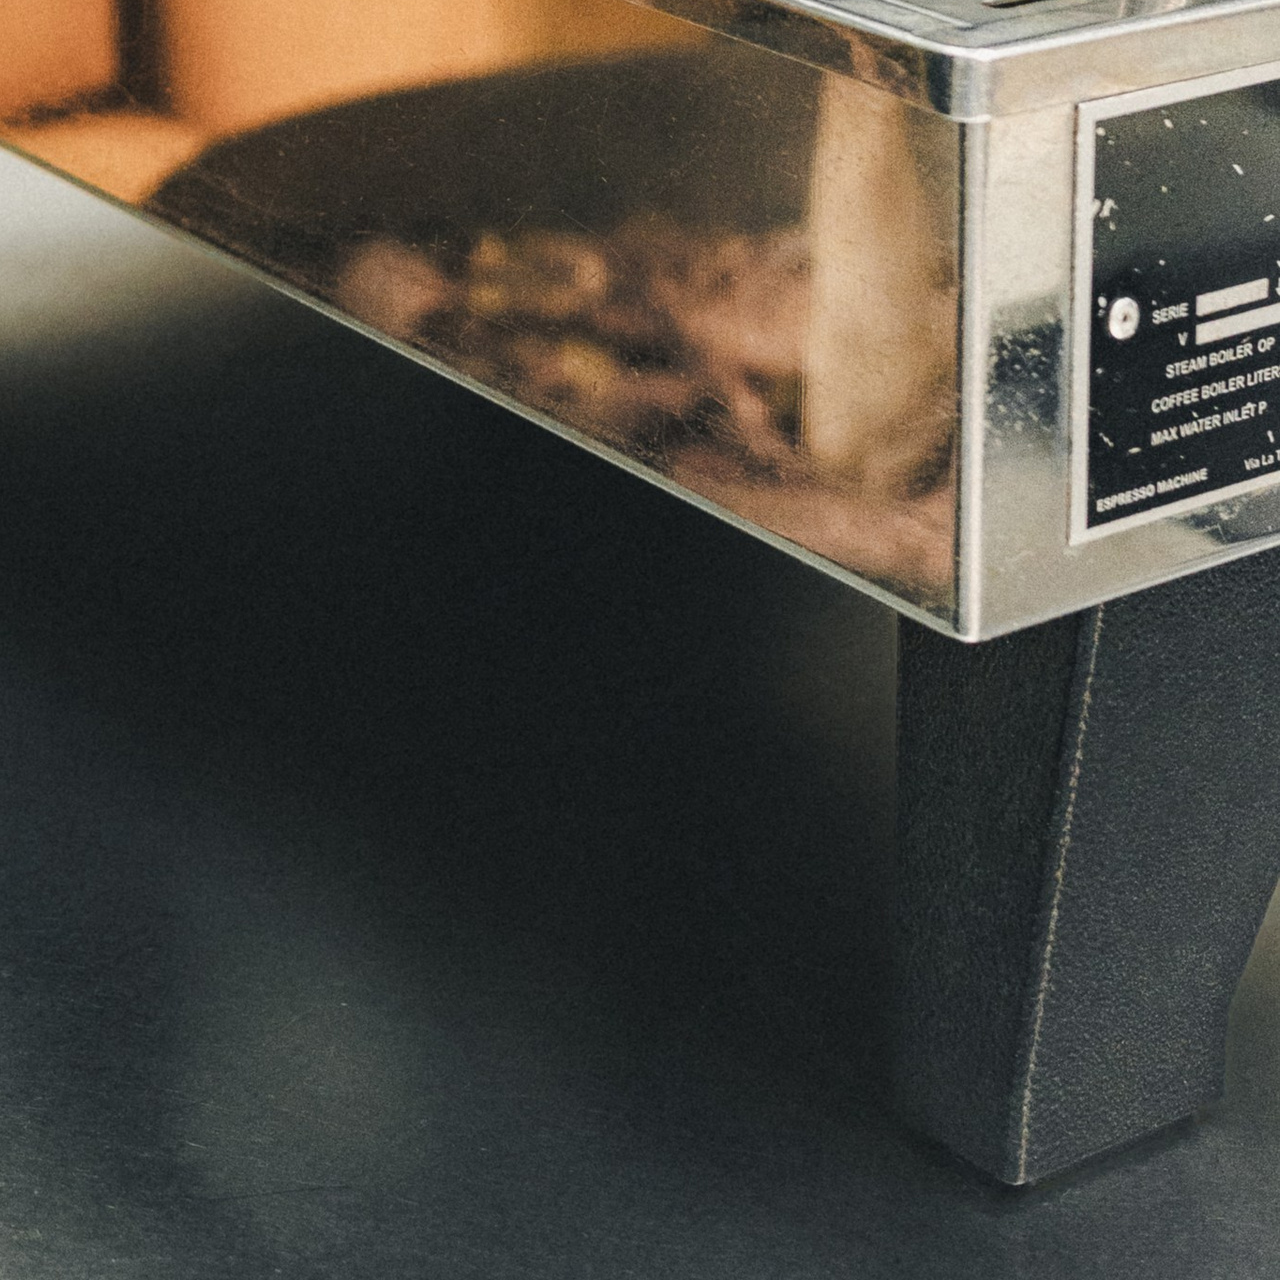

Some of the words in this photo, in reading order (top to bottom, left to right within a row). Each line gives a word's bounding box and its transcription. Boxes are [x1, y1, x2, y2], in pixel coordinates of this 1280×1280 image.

[1152, 302, 1189, 325] SERIE
[1177, 332, 1188, 346] V
[1165, 355, 1207, 379] STEAM
[1209, 343, 1253, 366] BOILER
[1151, 388, 1199, 414] COFFEE
[1201, 376, 1245, 399] BOILER
[1247, 365, 1280, 387] LITER
[1151, 426, 1179, 447] MAX
[1179, 414, 1222, 437] WATER
[1223, 403, 1257, 425] INLET
[1243, 457, 1260, 471] Via
[1262, 454, 1275, 467] La
[1096, 484, 1156, 513] ESPRESSO
[1157, 468, 1209, 494] MACHINE
